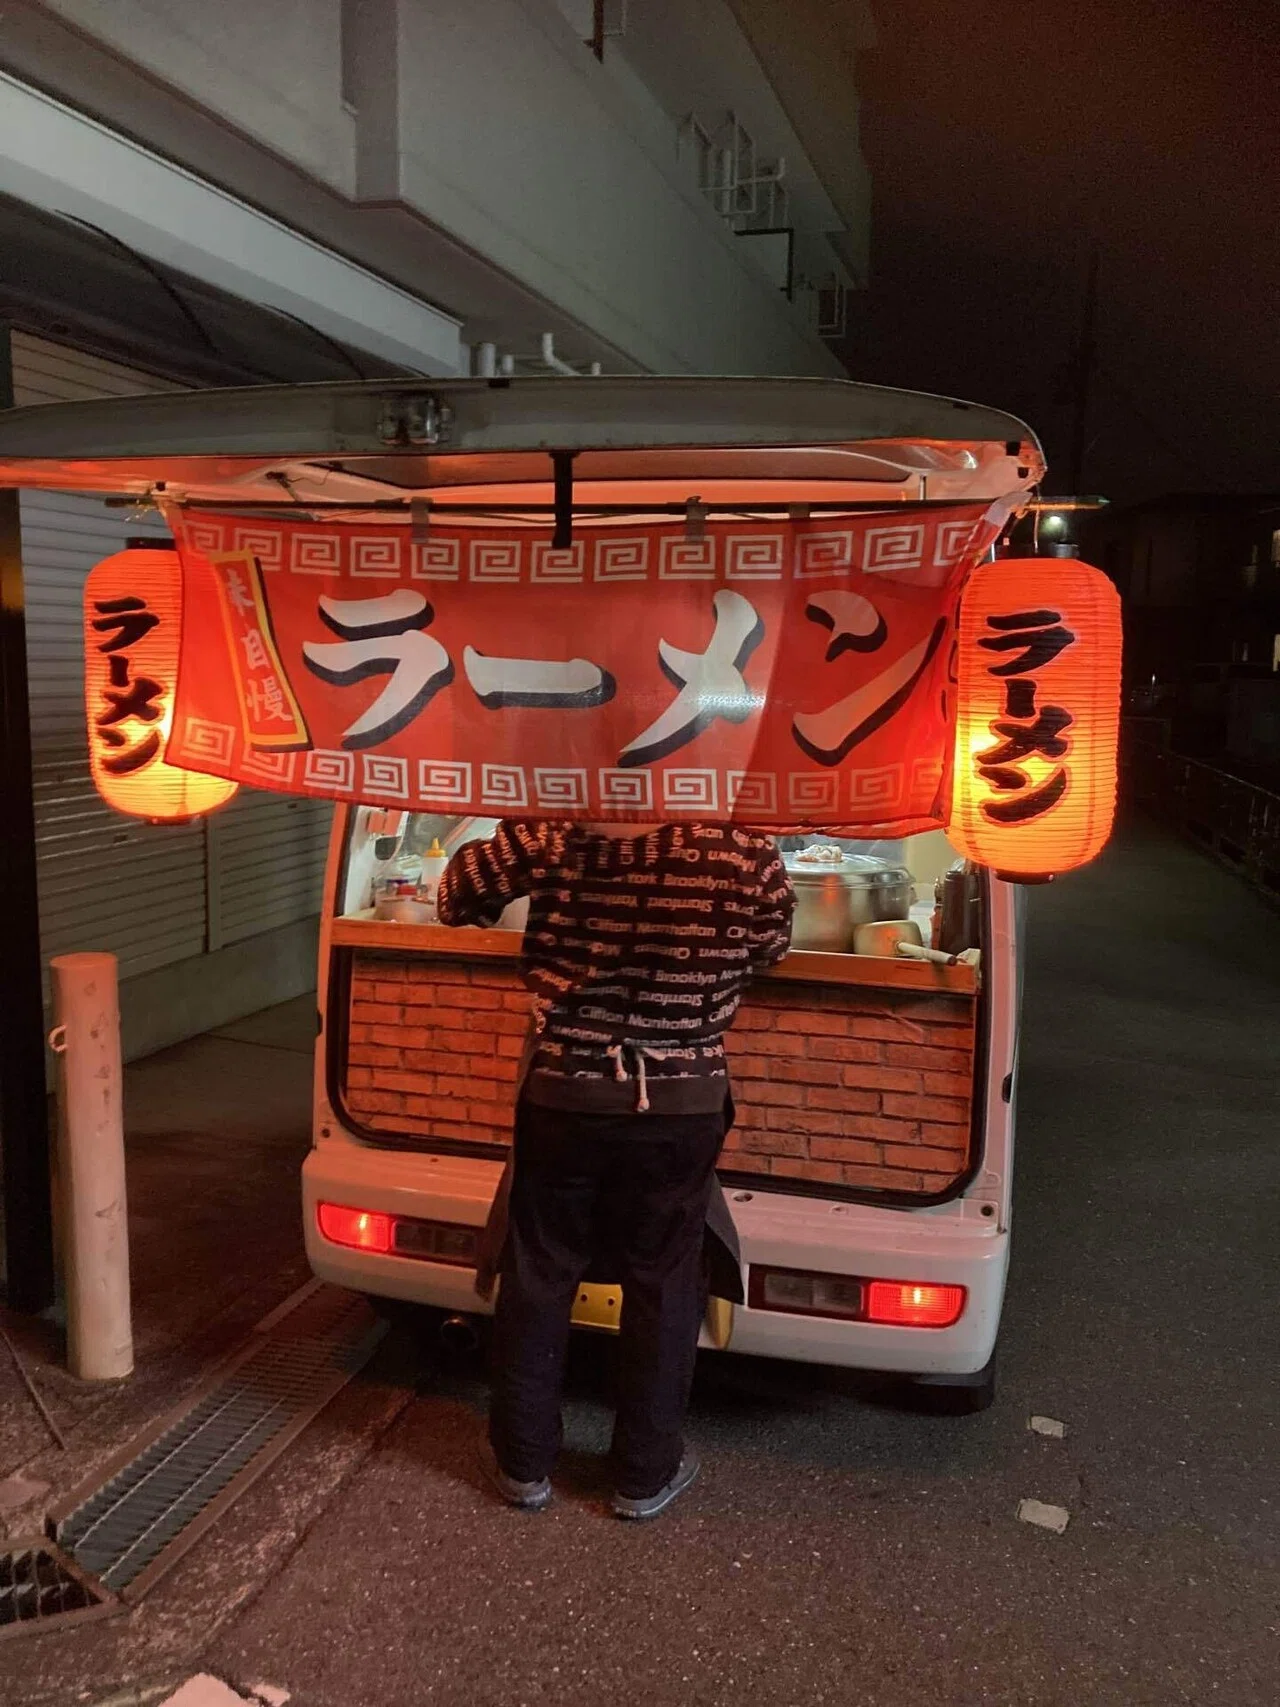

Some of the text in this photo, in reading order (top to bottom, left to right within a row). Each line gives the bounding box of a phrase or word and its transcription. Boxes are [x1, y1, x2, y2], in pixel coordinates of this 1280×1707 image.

[91, 595, 165, 776] ラーメン
[303, 587, 947, 768] ラーメン
[976, 609, 1076, 823] ラーメン
[663, 873, 729, 891] Brooklyn
[654, 969, 717, 986] Brooklyn
[637, 990, 705, 1007] Stamford
[577, 1005, 625, 1023] Clifton
[628, 1013, 702, 1030] Manhattan
